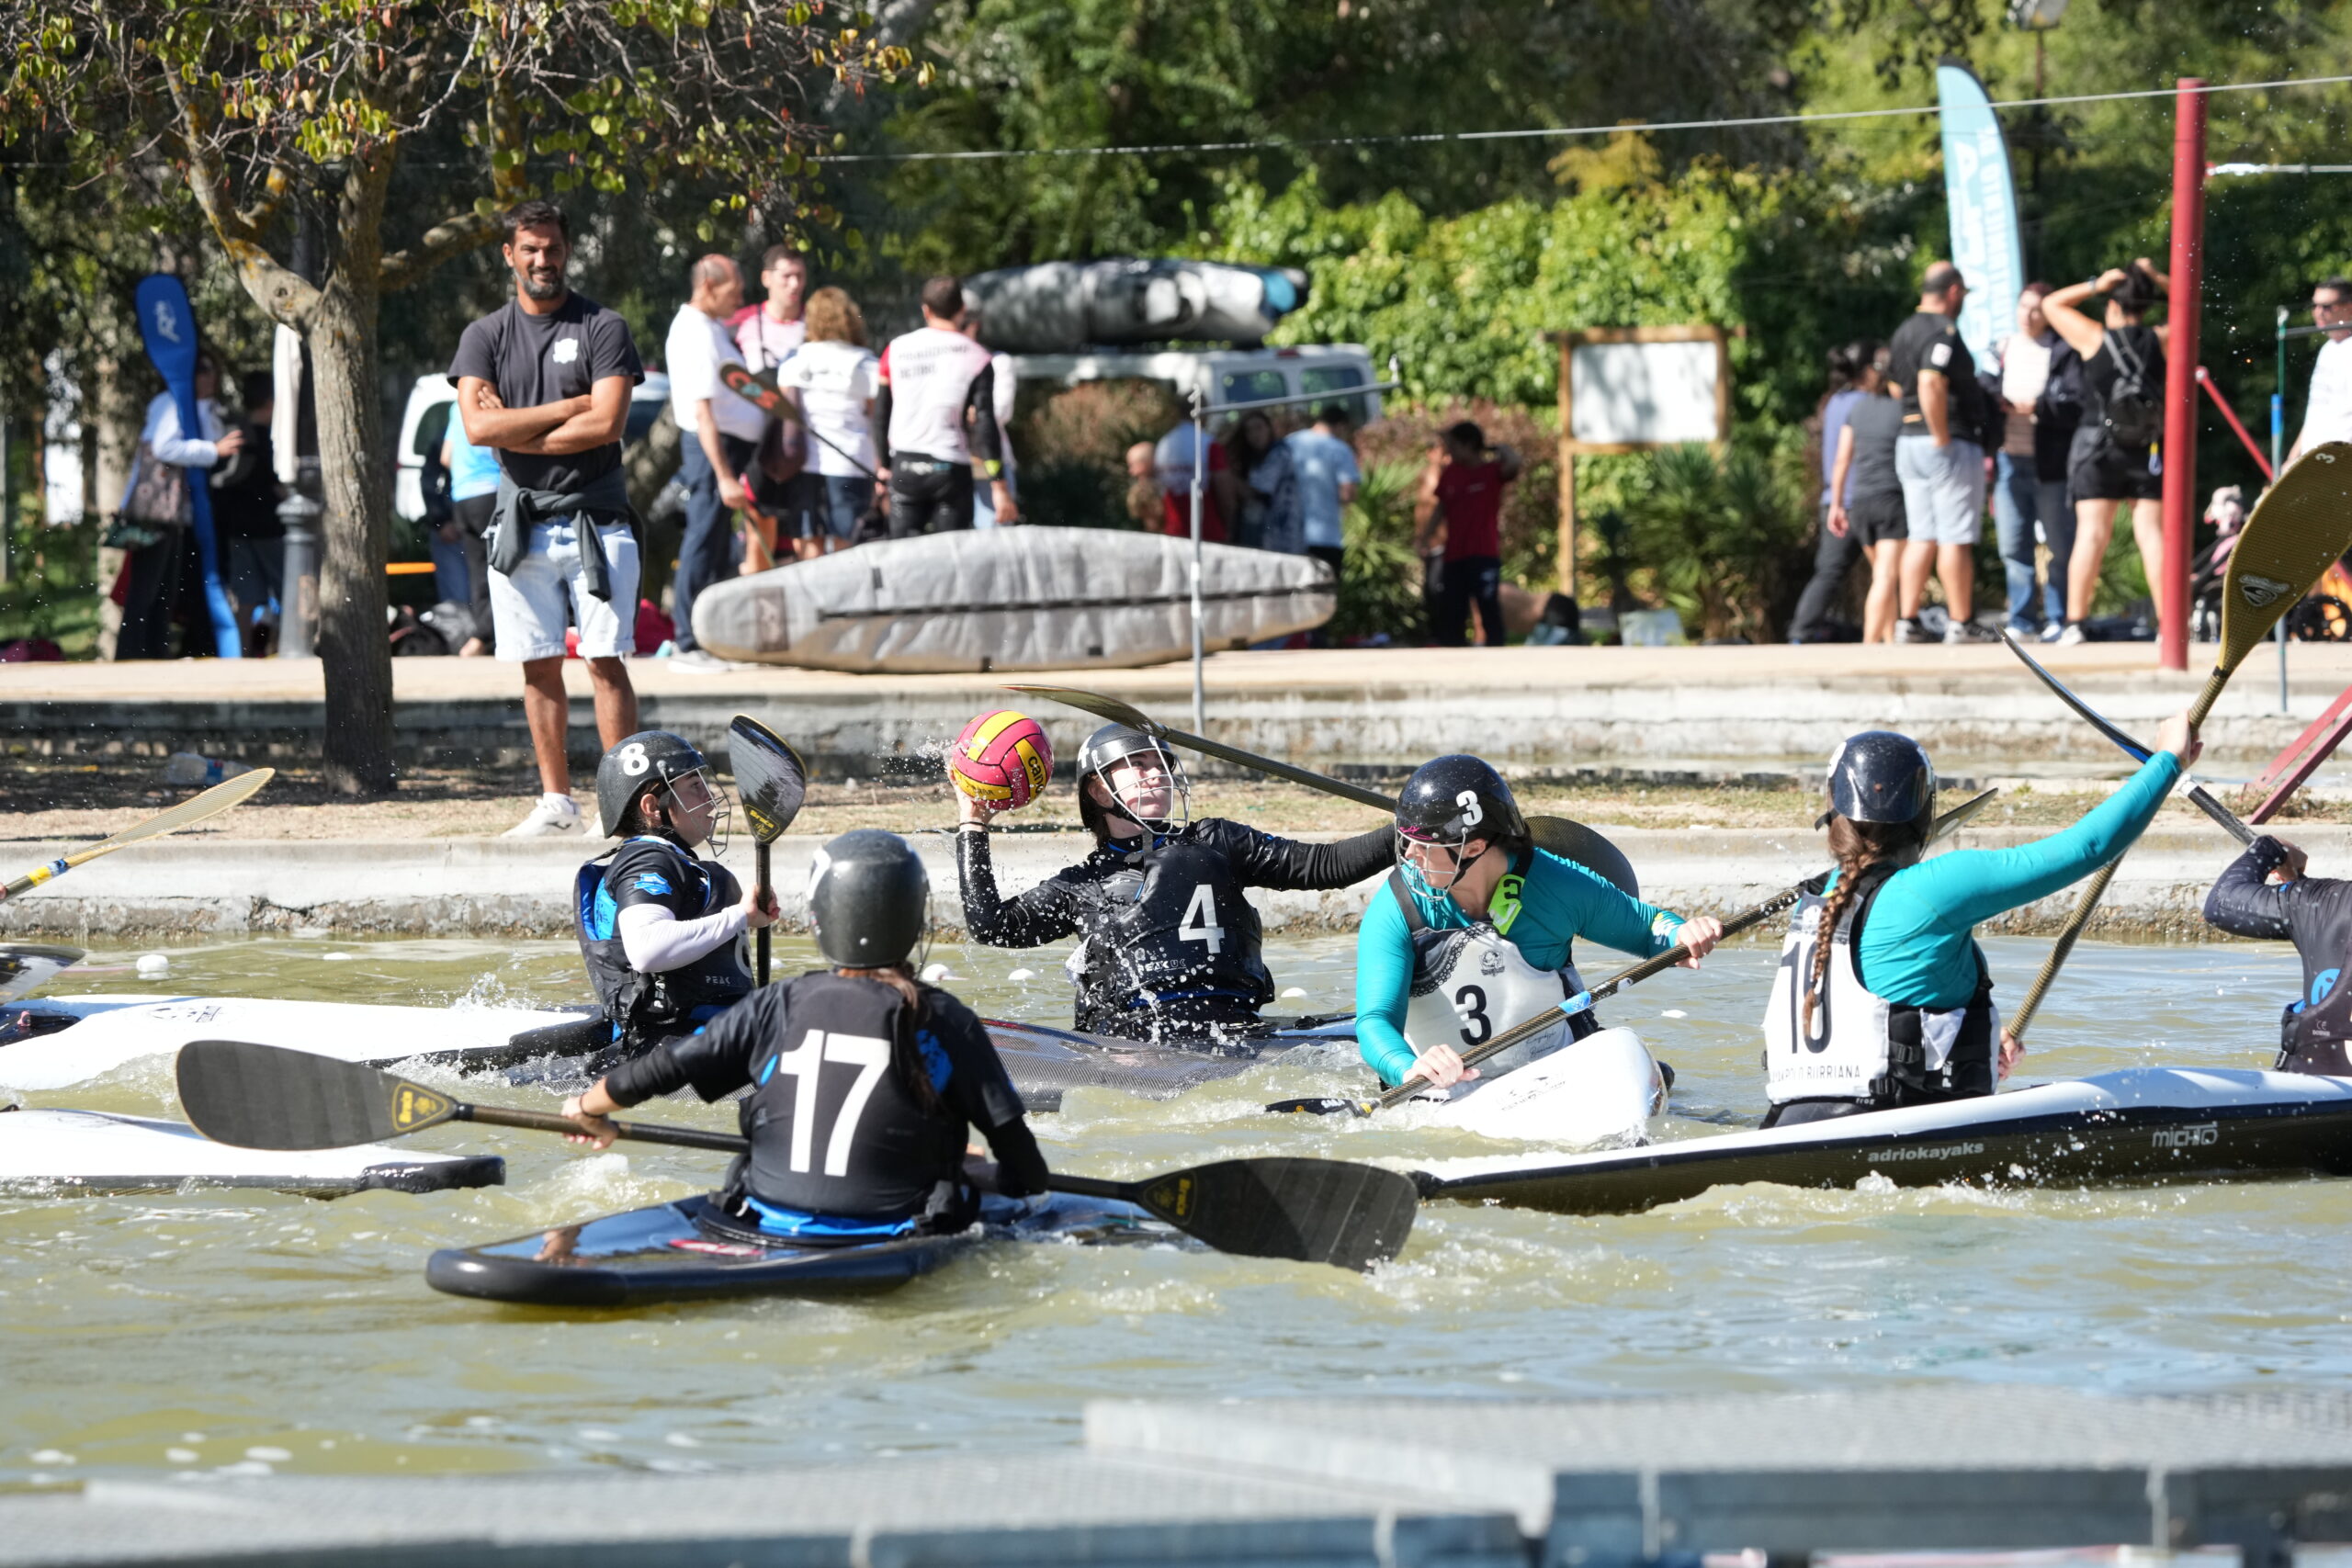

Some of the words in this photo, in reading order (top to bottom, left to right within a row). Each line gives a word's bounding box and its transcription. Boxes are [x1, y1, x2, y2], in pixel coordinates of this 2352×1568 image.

[620, 742, 650, 776] 8
[1456, 790, 1484, 826] 3
[1178, 884, 1226, 954] 4
[1455, 984, 1492, 1046] 3
[780, 1028, 891, 1178] 17
[1867, 1141, 1984, 1163] adriokayaks
